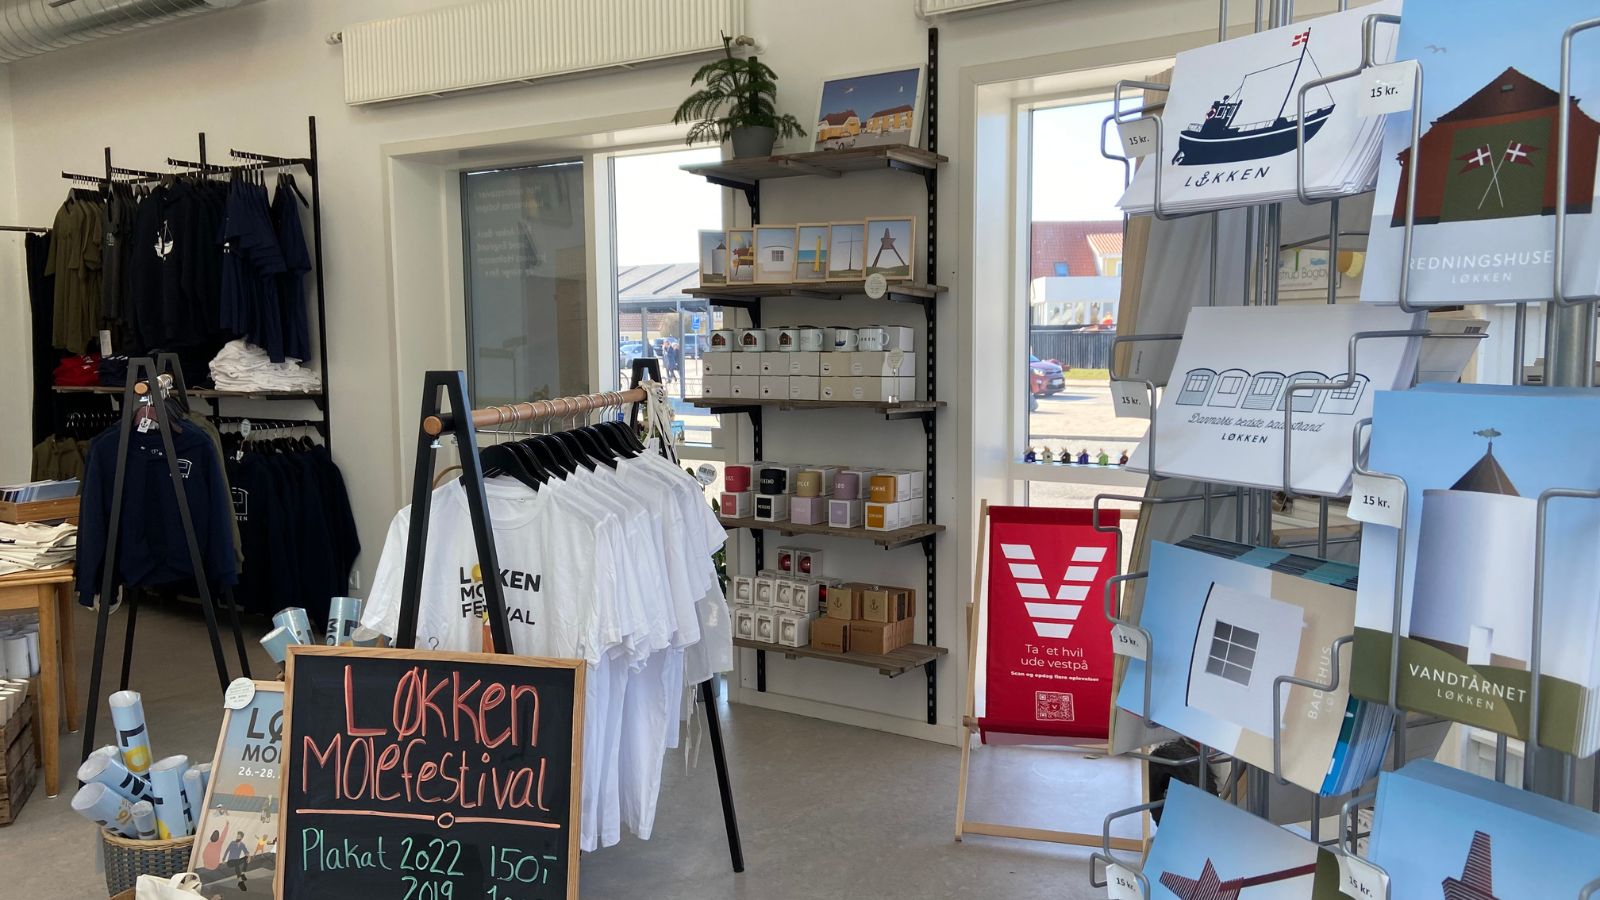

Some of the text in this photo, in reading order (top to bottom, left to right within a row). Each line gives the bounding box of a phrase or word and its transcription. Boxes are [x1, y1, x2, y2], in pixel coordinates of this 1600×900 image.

[1370, 85, 1399, 98] 15 kr.
[1129, 135, 1150, 146] 15 kr.
[1451, 271, 1512, 284] LØKKEN
[1121, 396, 1141, 406] 15 kr.
[1221, 432, 1269, 444] LØKKEN
[1362, 494, 1390, 509] 15 kr.
[460, 566, 541, 592] LKEN
[1119, 635, 1128, 644] 15
[1025, 644, 1039, 654] Ta
[1062, 647, 1083, 657] hvil
[1021, 657, 1088, 671] ude vestpå
[1408, 663, 1527, 703] VANDTÅRNET
[1437, 688, 1495, 711] LØKKEN
[302, 827, 393, 871] Plakat
[400, 837, 465, 876] 2022
[1116, 877, 1126, 887] 15
[1349, 875, 1373, 898] 15 kr.
